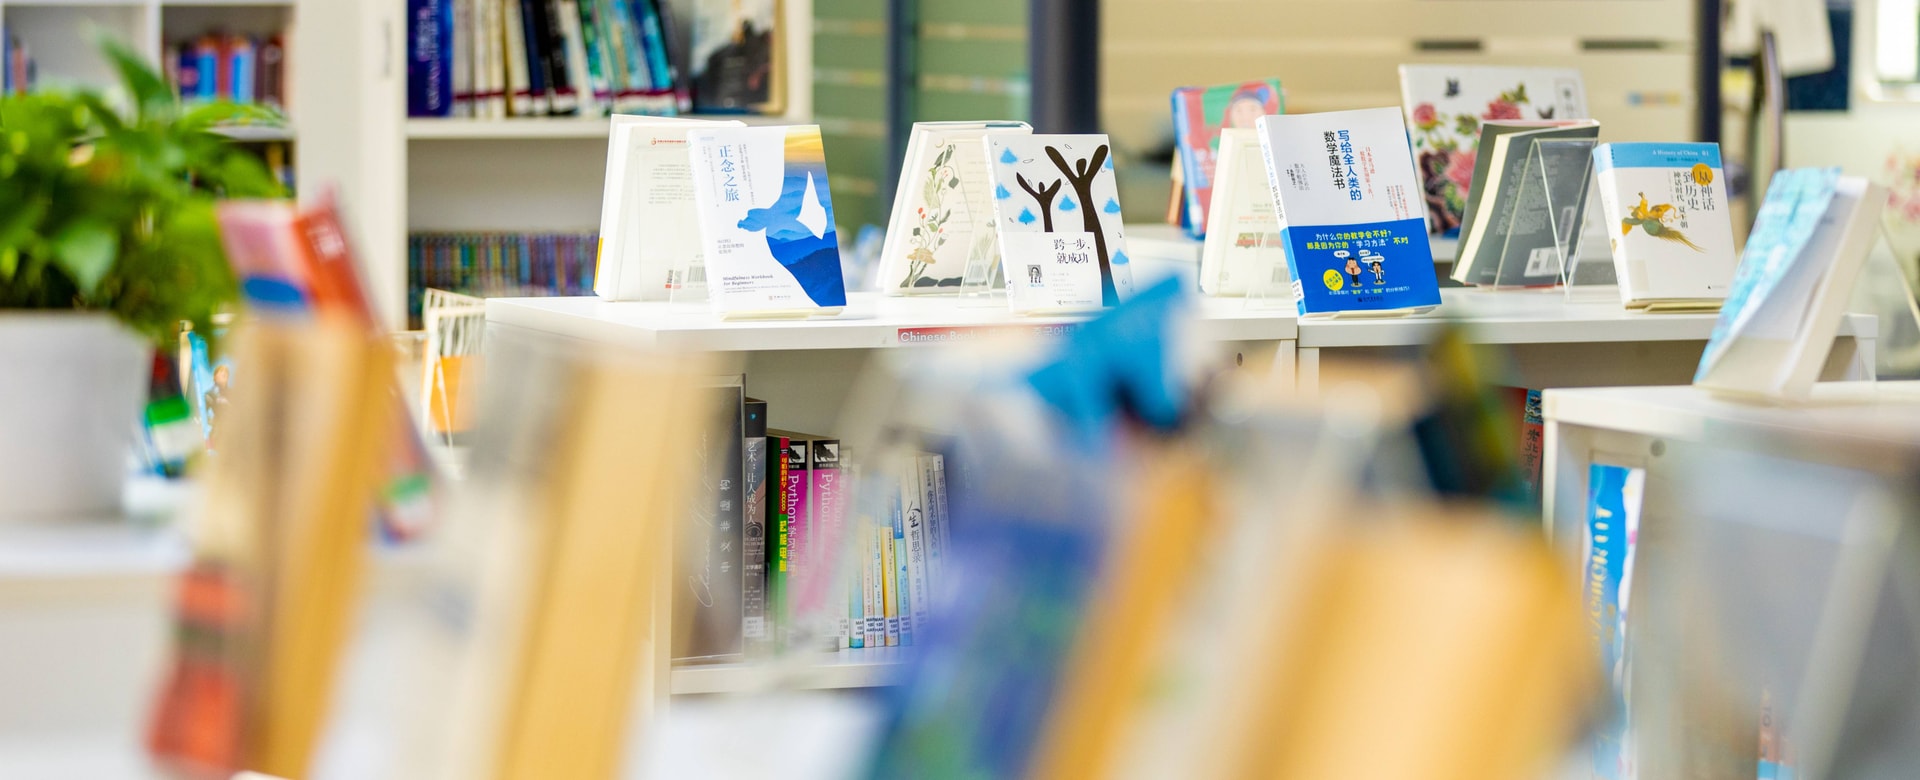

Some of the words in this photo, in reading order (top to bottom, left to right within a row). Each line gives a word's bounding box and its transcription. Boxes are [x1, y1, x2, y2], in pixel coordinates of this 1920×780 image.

[719, 144, 740, 202] 正念之旅
[1323, 131, 1345, 190] 数学魔法书
[1338, 130, 1362, 201] 写给全人类的
[1683, 170, 1700, 211] 到历史
[1699, 170, 1715, 211] 从神话
[1056, 252, 1089, 264] 就成功
[900, 332, 947, 342] Chinese
[950, 331, 977, 341] Book
[746, 441, 757, 525] 艺术：让人成为人
[788, 475, 800, 524] Python
[821, 472, 834, 523] Python
[719, 479, 733, 573] 中文非虚构
[907, 500, 922, 562] 人生哲思录
